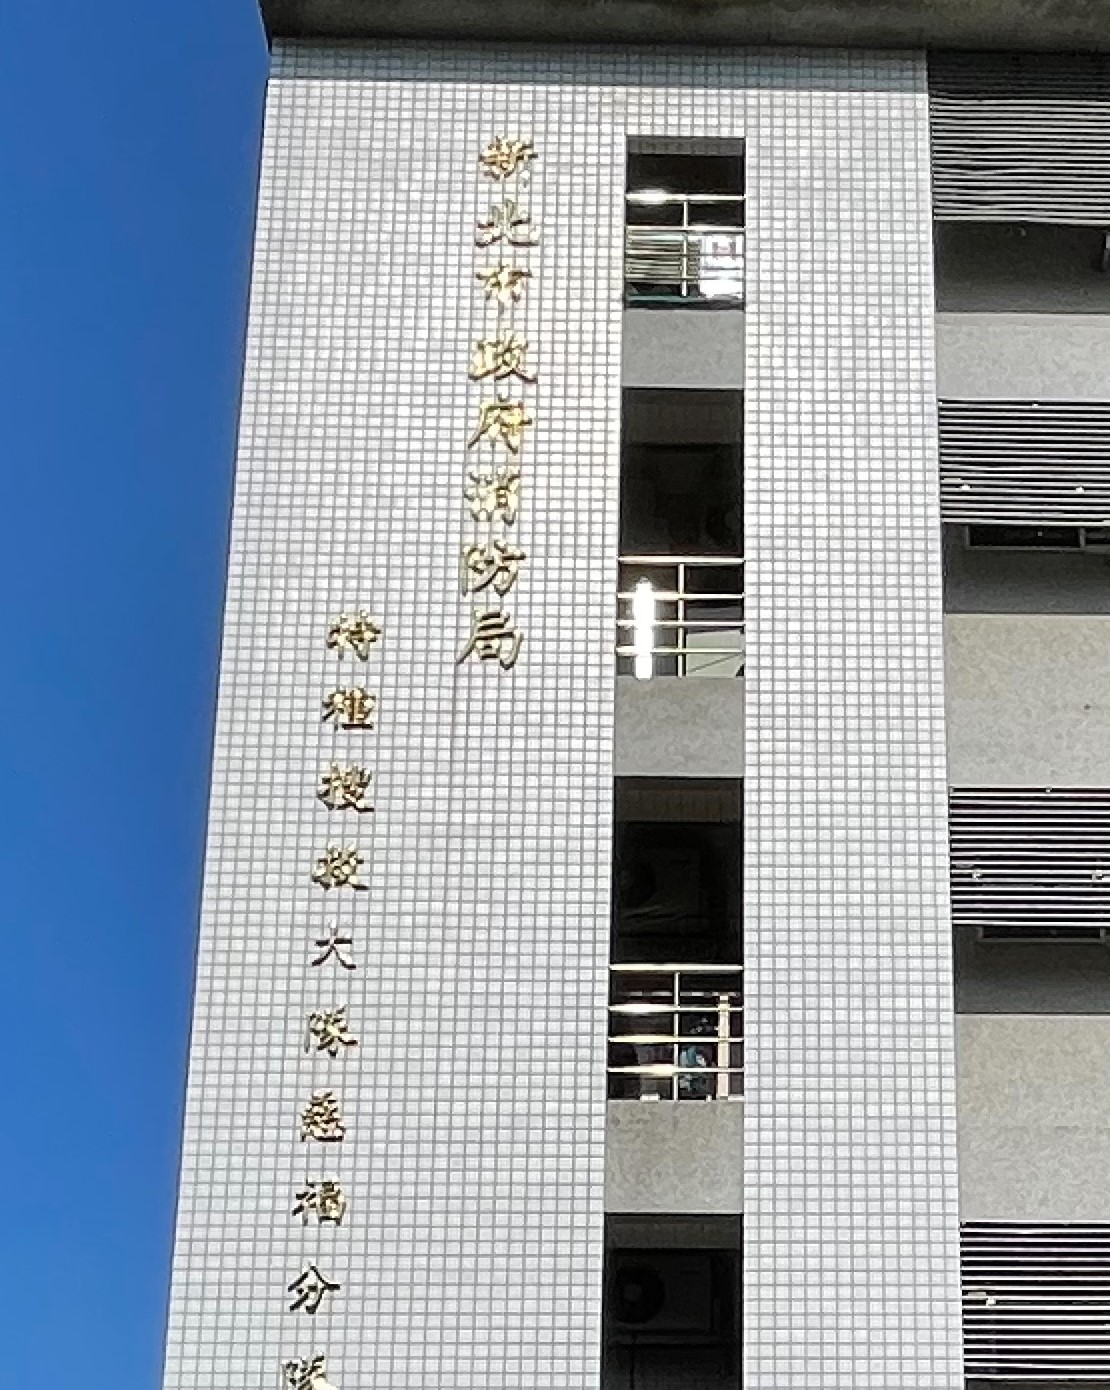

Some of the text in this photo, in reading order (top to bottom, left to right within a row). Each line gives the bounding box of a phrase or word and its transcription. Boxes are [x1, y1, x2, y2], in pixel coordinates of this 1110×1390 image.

[456, 134, 539, 669] 新北市政府消防局
